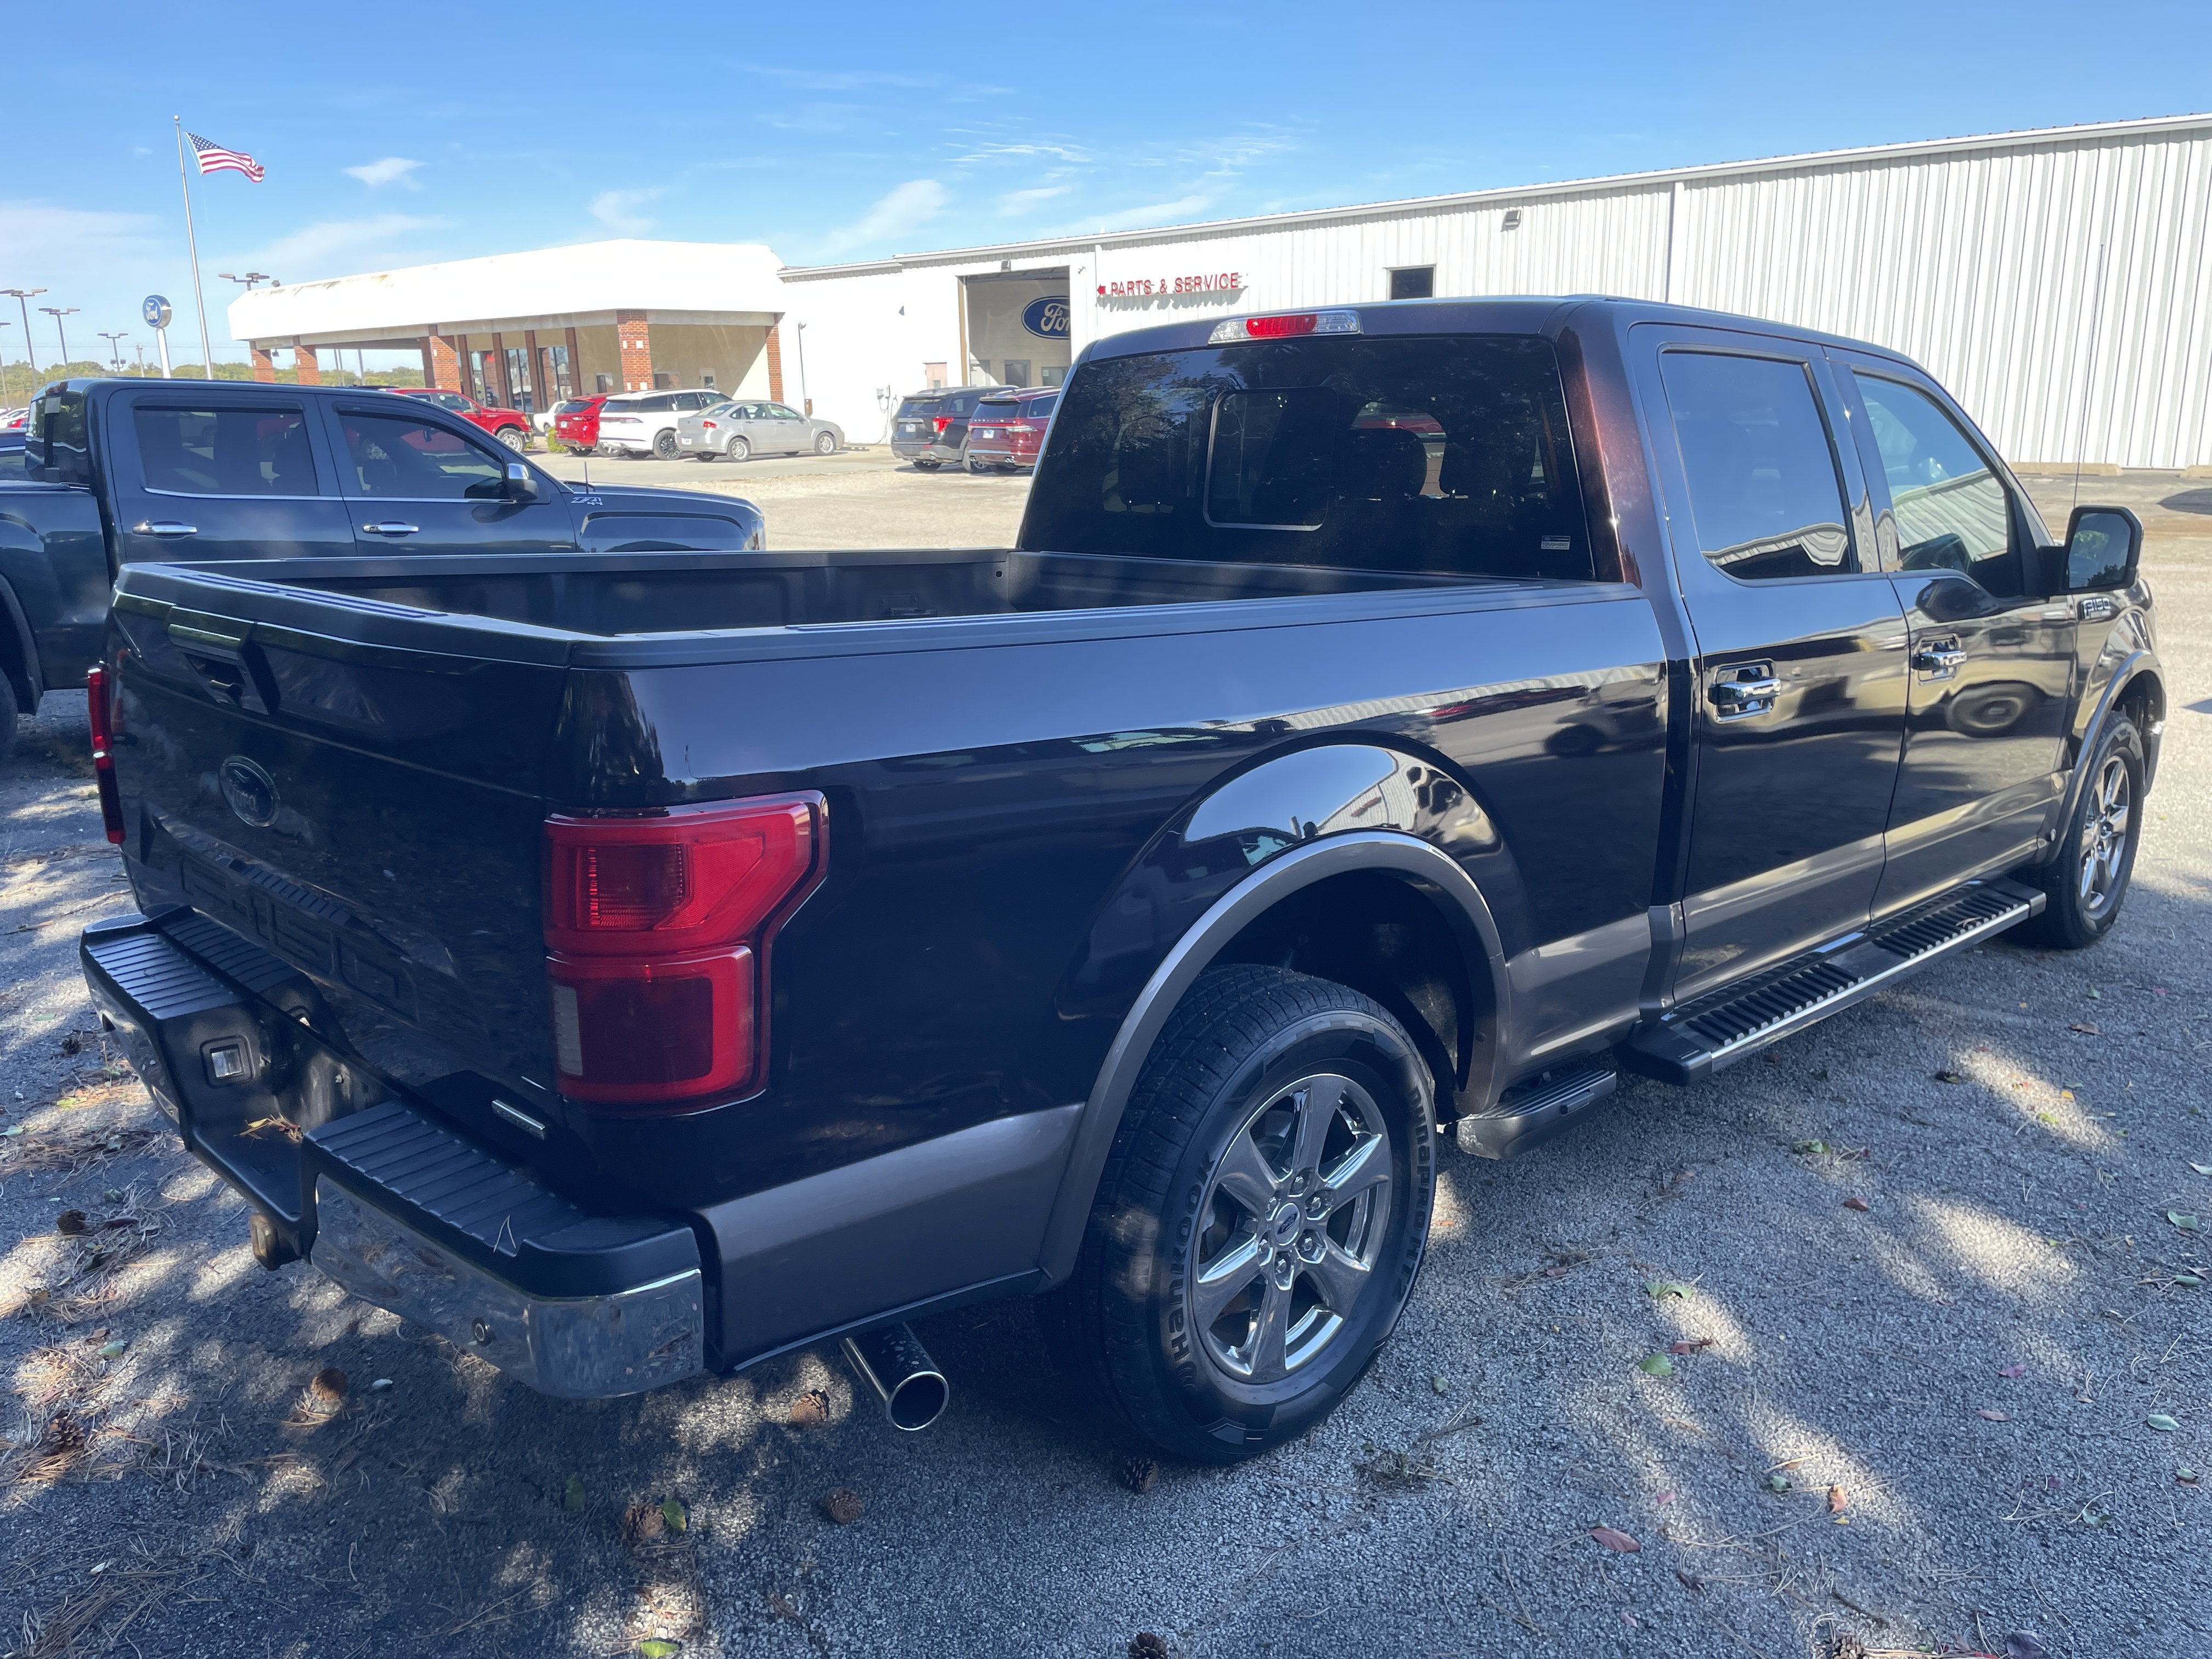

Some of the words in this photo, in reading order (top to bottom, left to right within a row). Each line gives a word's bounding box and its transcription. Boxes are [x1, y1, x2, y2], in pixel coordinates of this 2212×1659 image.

[1110, 279, 1152, 297] PARTS
[1159, 279, 1167, 294] &
[1174, 272, 1239, 294] SERVICE
[1040, 303, 1071, 332] For
